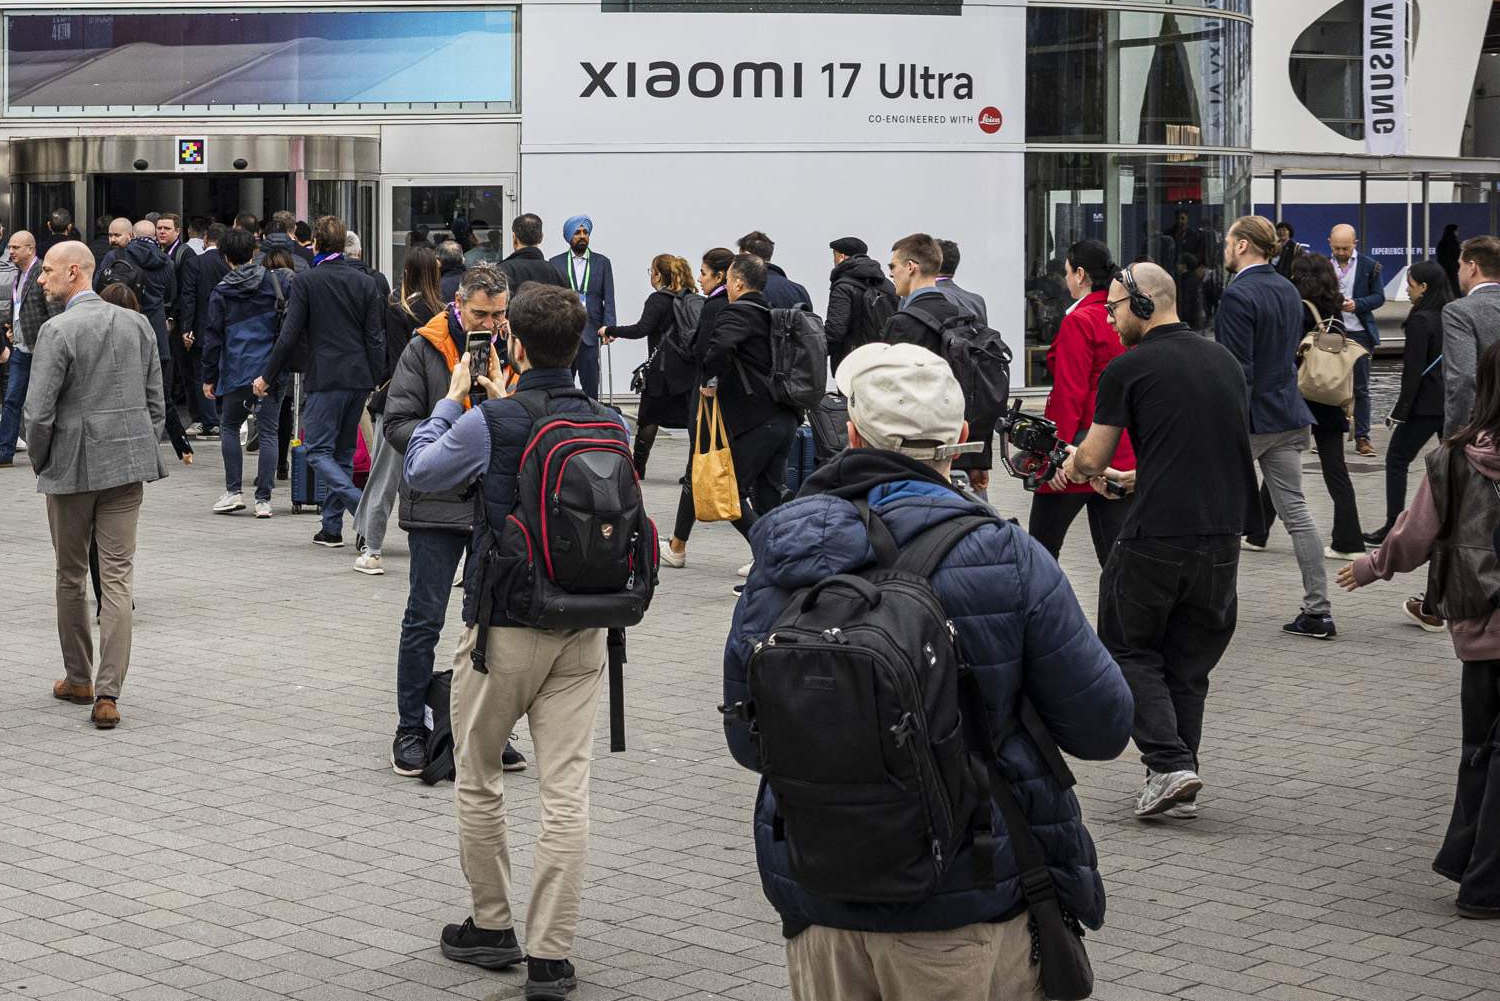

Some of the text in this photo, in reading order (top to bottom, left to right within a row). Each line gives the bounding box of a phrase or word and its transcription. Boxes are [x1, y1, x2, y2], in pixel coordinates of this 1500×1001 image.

[821, 62, 862, 98] 17
[878, 63, 973, 100] Ultra
[868, 114, 974, 124] CO-ENGINEERED WITH
